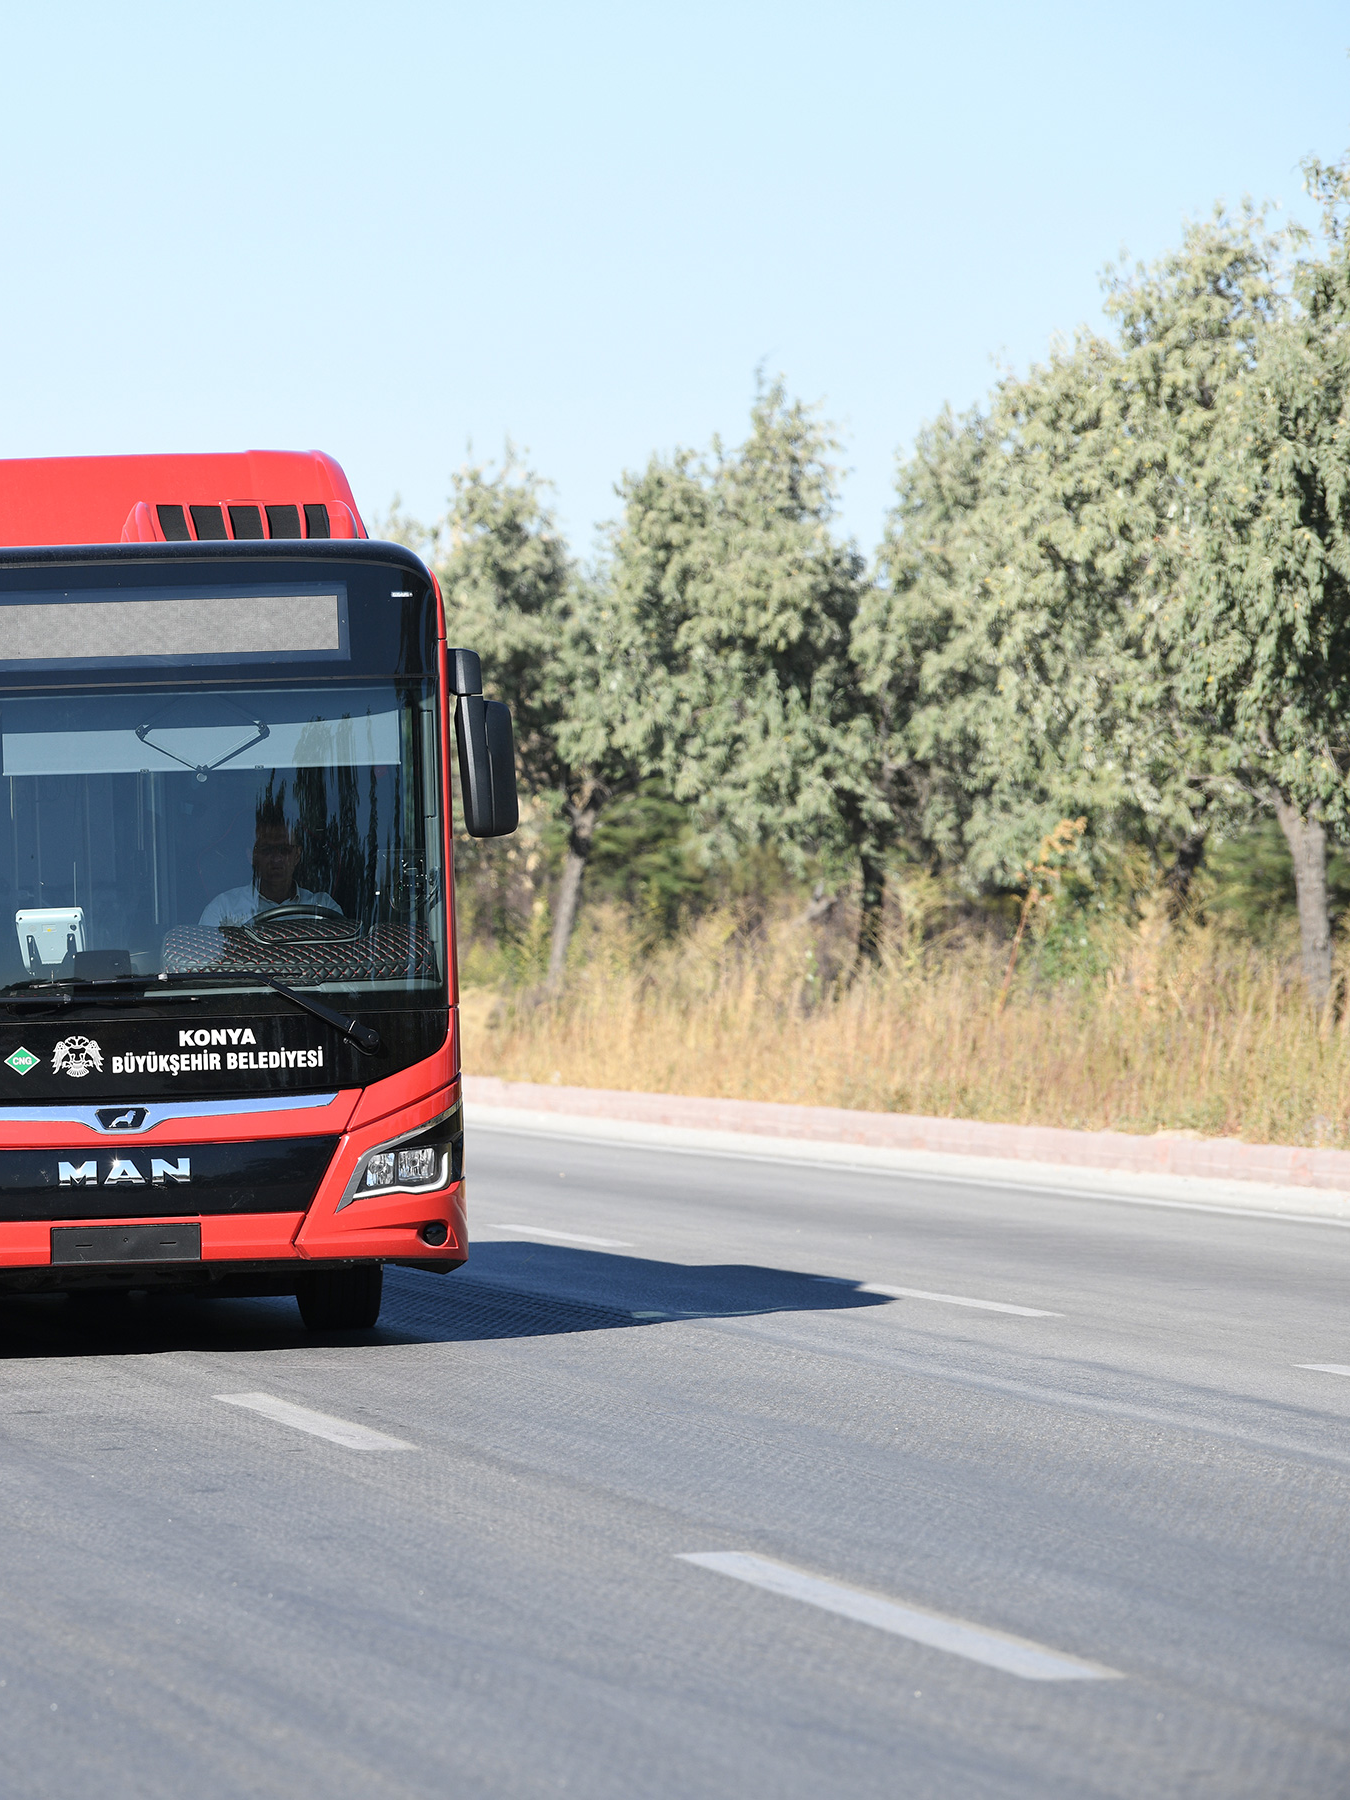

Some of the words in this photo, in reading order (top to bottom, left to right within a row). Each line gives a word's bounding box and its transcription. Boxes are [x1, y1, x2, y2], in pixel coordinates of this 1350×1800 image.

[179, 1028, 256, 1046] KONYA
[12, 1056, 32, 1066] CNG
[112, 1049, 221, 1076] BÜYÜKŞEHİR
[227, 1046, 323, 1069] BELEDİYESİ
[58, 1157, 191, 1186] MAN
